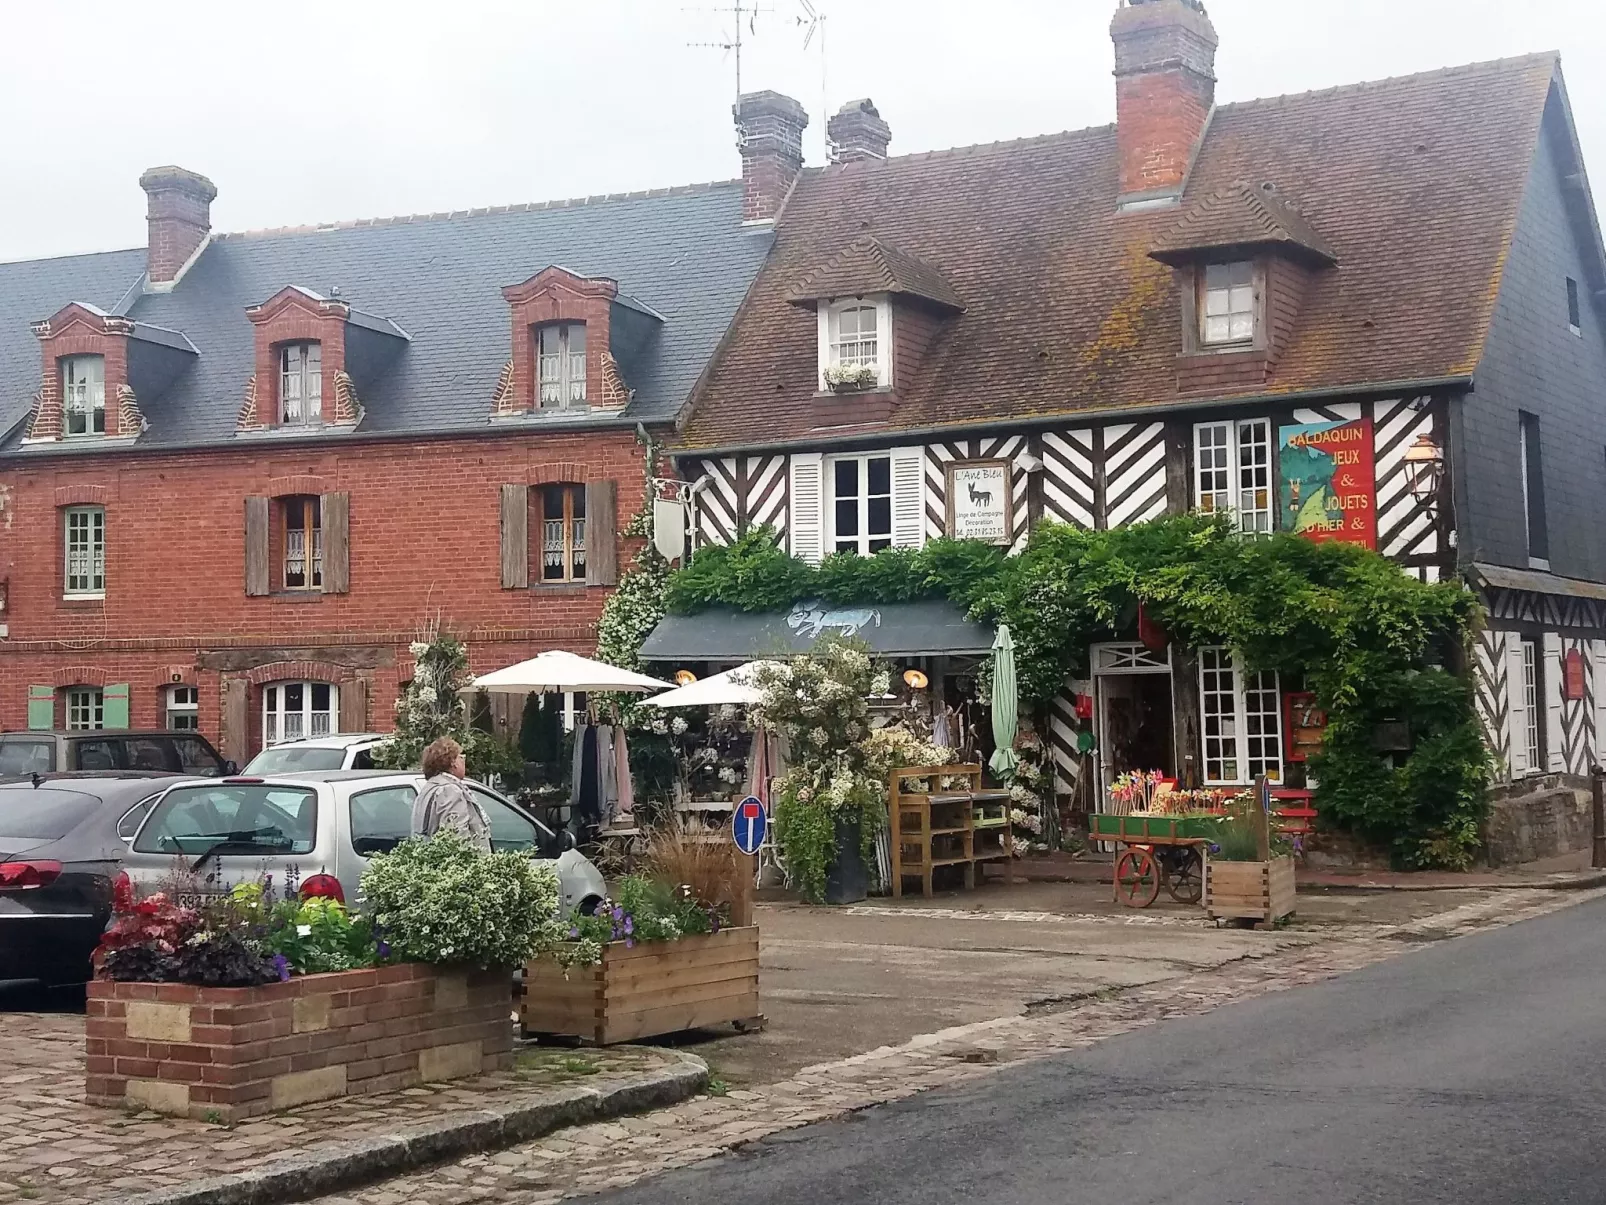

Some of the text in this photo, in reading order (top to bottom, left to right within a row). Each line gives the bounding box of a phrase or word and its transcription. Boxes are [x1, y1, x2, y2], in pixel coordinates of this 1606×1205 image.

[1288, 428, 1363, 447] BALDAQUIN
[1331, 450, 1360, 466] JEUX
[982, 469, 1002, 479] Bleu
[1340, 473, 1354, 487] &
[1325, 494, 1368, 511] JOUETS
[1306, 516, 1365, 533] D'HIER &
